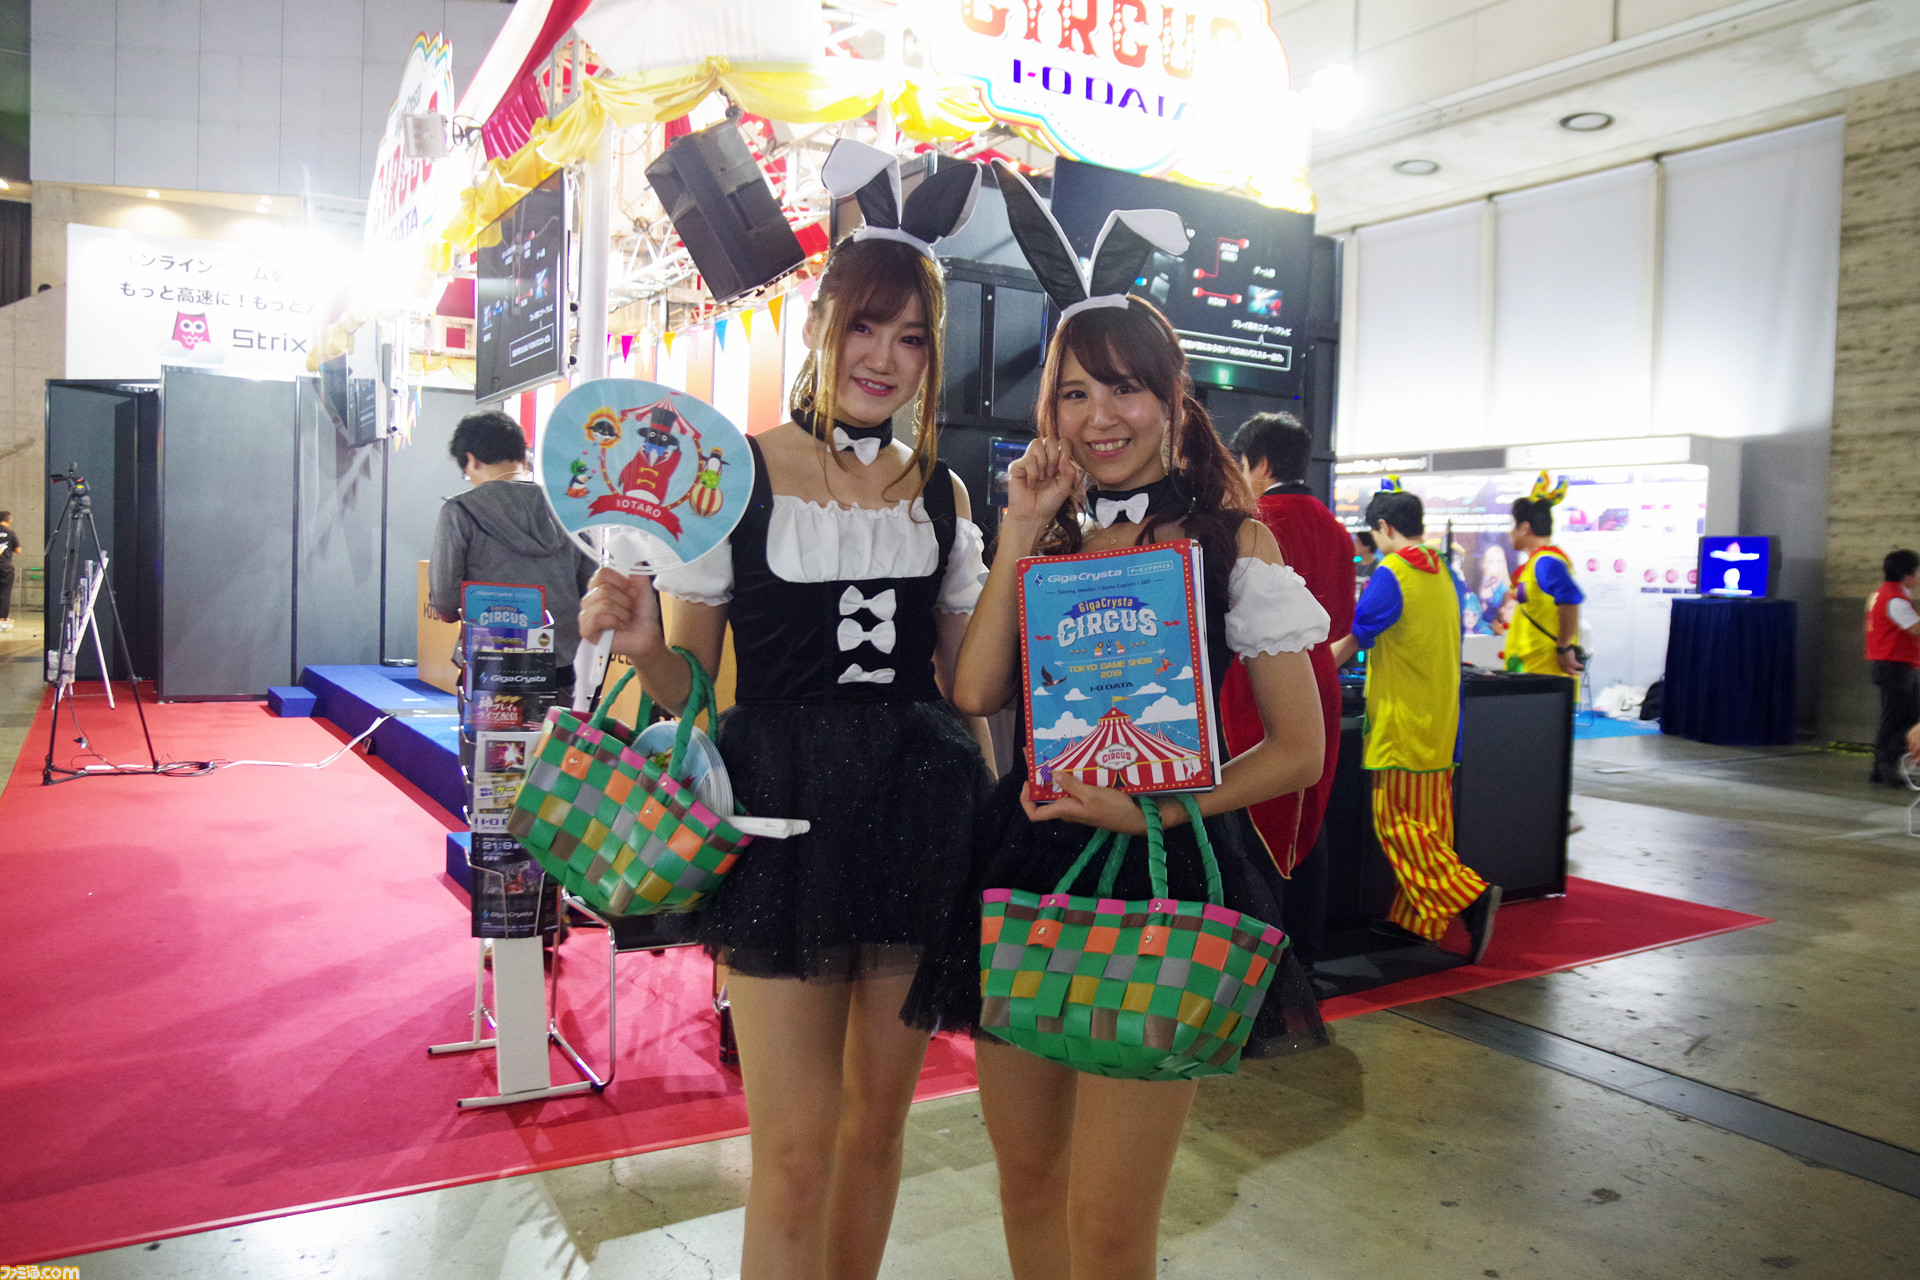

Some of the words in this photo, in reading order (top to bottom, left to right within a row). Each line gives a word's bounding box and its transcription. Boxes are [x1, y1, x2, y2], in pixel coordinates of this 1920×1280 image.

[1013, 58, 1072, 96] I-O
[1220, 243, 1240, 253] HDMI
[1207, 297, 1227, 307] HDMI
[232, 328, 309, 353] Strix
[616, 499, 662, 518] IOTARO
[1047, 568, 1123, 584] GigaCrysta
[1079, 597, 1133, 613] GigaCrysta
[479, 611, 529, 628] CIRCUS
[1057, 608, 1159, 648] CIRCUS
[1069, 664, 1098, 673] TOKYO
[1100, 661, 1126, 670] GAME
[1128, 657, 1153, 666] SHOW
[490, 674, 547, 684] GigaCrysta
[1101, 670, 1122, 679] 2019
[1090, 684, 1104, 692] I-O
[1105, 681, 1134, 691] DATA
[477, 710, 518, 721] ライブ配信
[1102, 751, 1132, 763] CIRCUS
[481, 817, 499, 826] I-O
